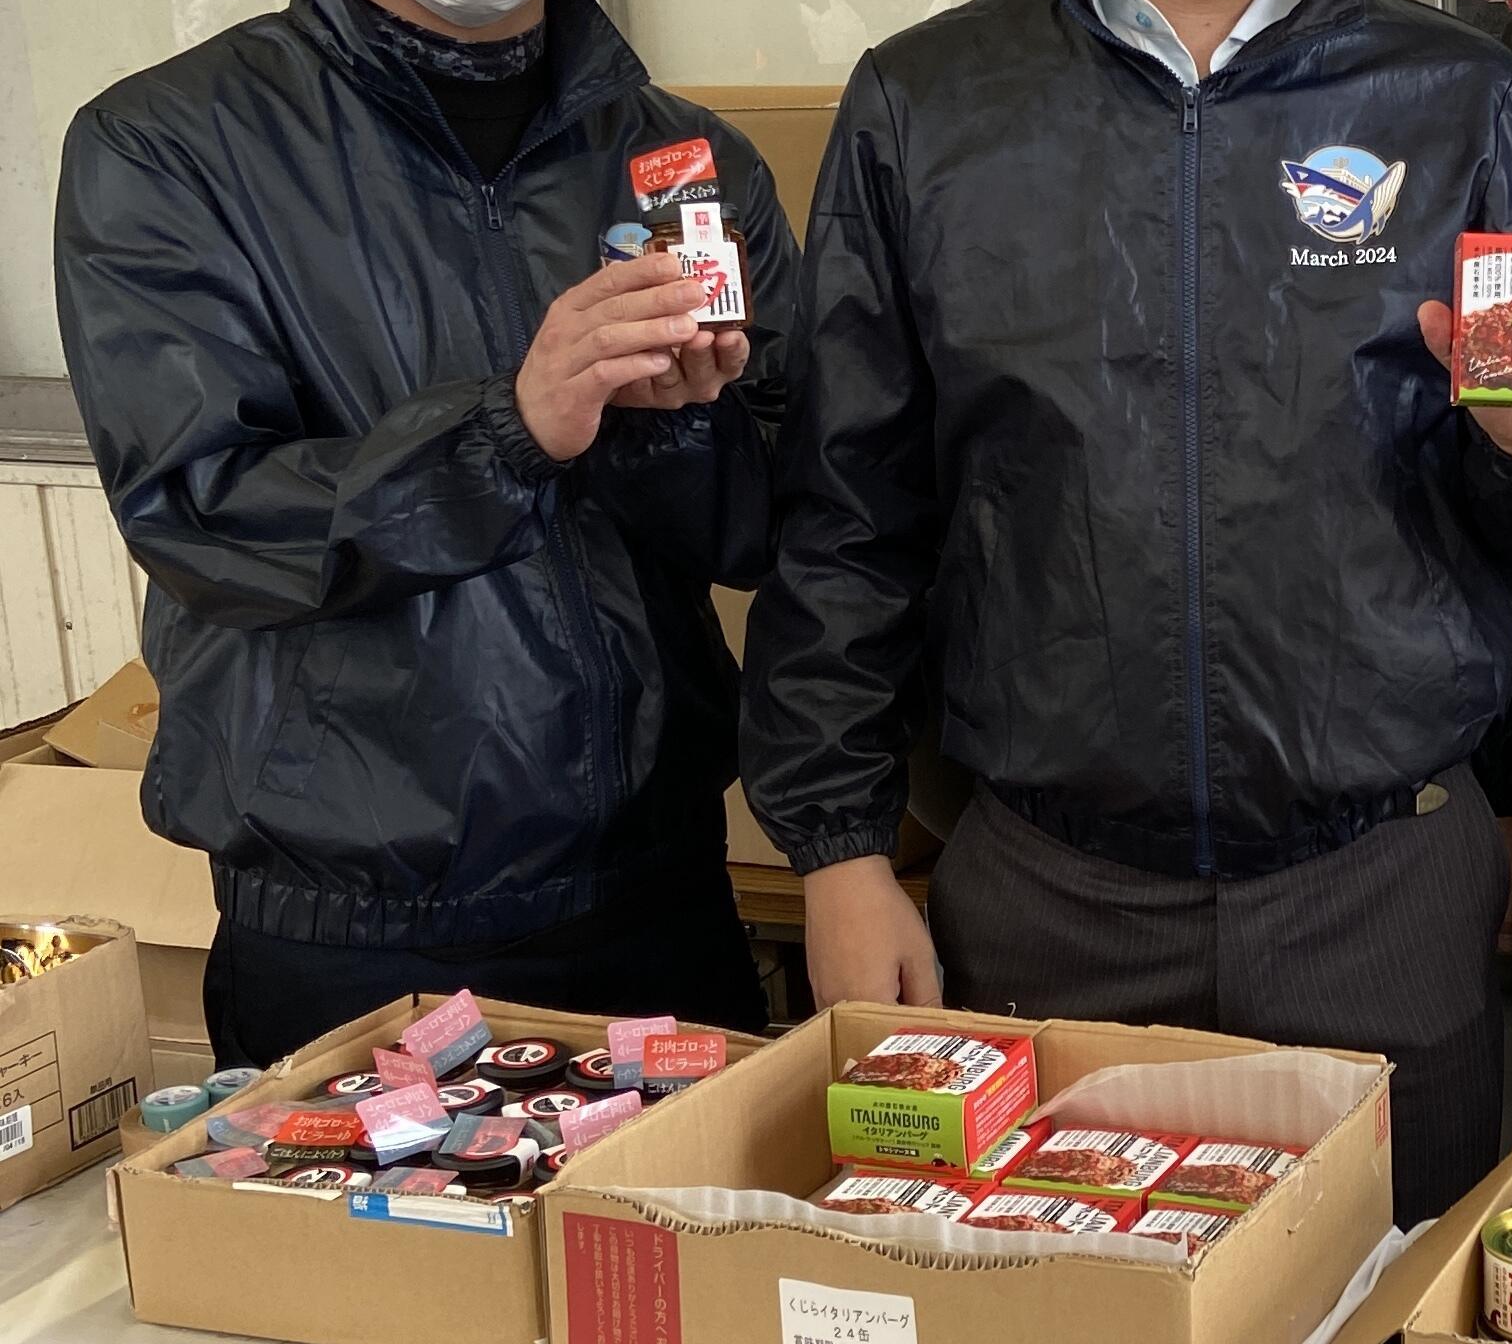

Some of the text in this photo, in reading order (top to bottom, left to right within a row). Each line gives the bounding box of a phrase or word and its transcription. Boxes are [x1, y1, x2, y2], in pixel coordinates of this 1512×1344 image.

[639, 145, 702, 174] お肉ゴロっと
[1290, 247, 1397, 267] March 2024
[651, 1039, 718, 1054] お肉ゴロっと
[655, 1057, 717, 1072] くじラーゆ
[293, 1116, 362, 1128] お肉ゴロっと
[850, 1108, 940, 1131] ITALIANBURG
[291, 1129, 352, 1142] くじラーゆ
[789, 1298, 909, 1329] くじらイタリアンバーグ
